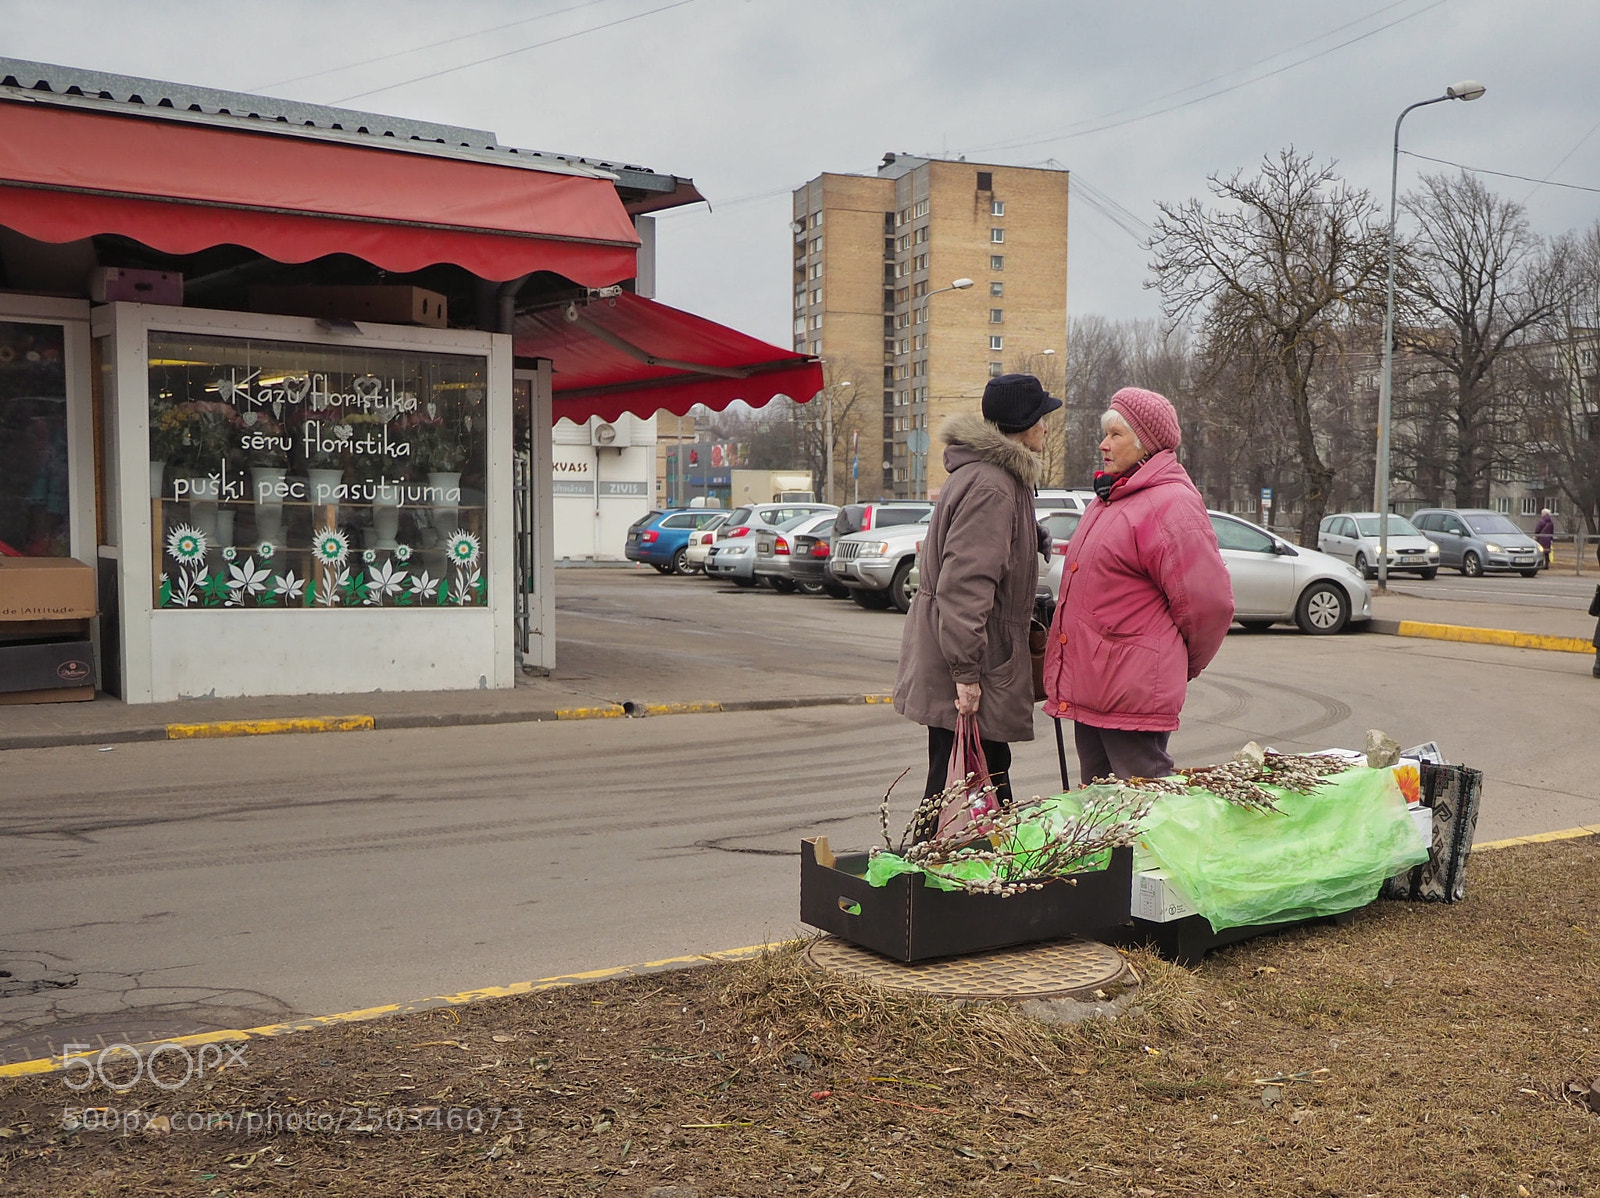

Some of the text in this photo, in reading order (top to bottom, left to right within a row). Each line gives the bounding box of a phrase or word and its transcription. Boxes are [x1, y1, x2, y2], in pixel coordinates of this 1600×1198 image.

[310, 373, 418, 413] floristika
[241, 420, 411, 459] sēru floristika
[173, 457, 462, 508] pušķi pēc pasūtījuma
[552, 462, 588, 472] KVASS
[609, 483, 638, 494] ZIVIS
